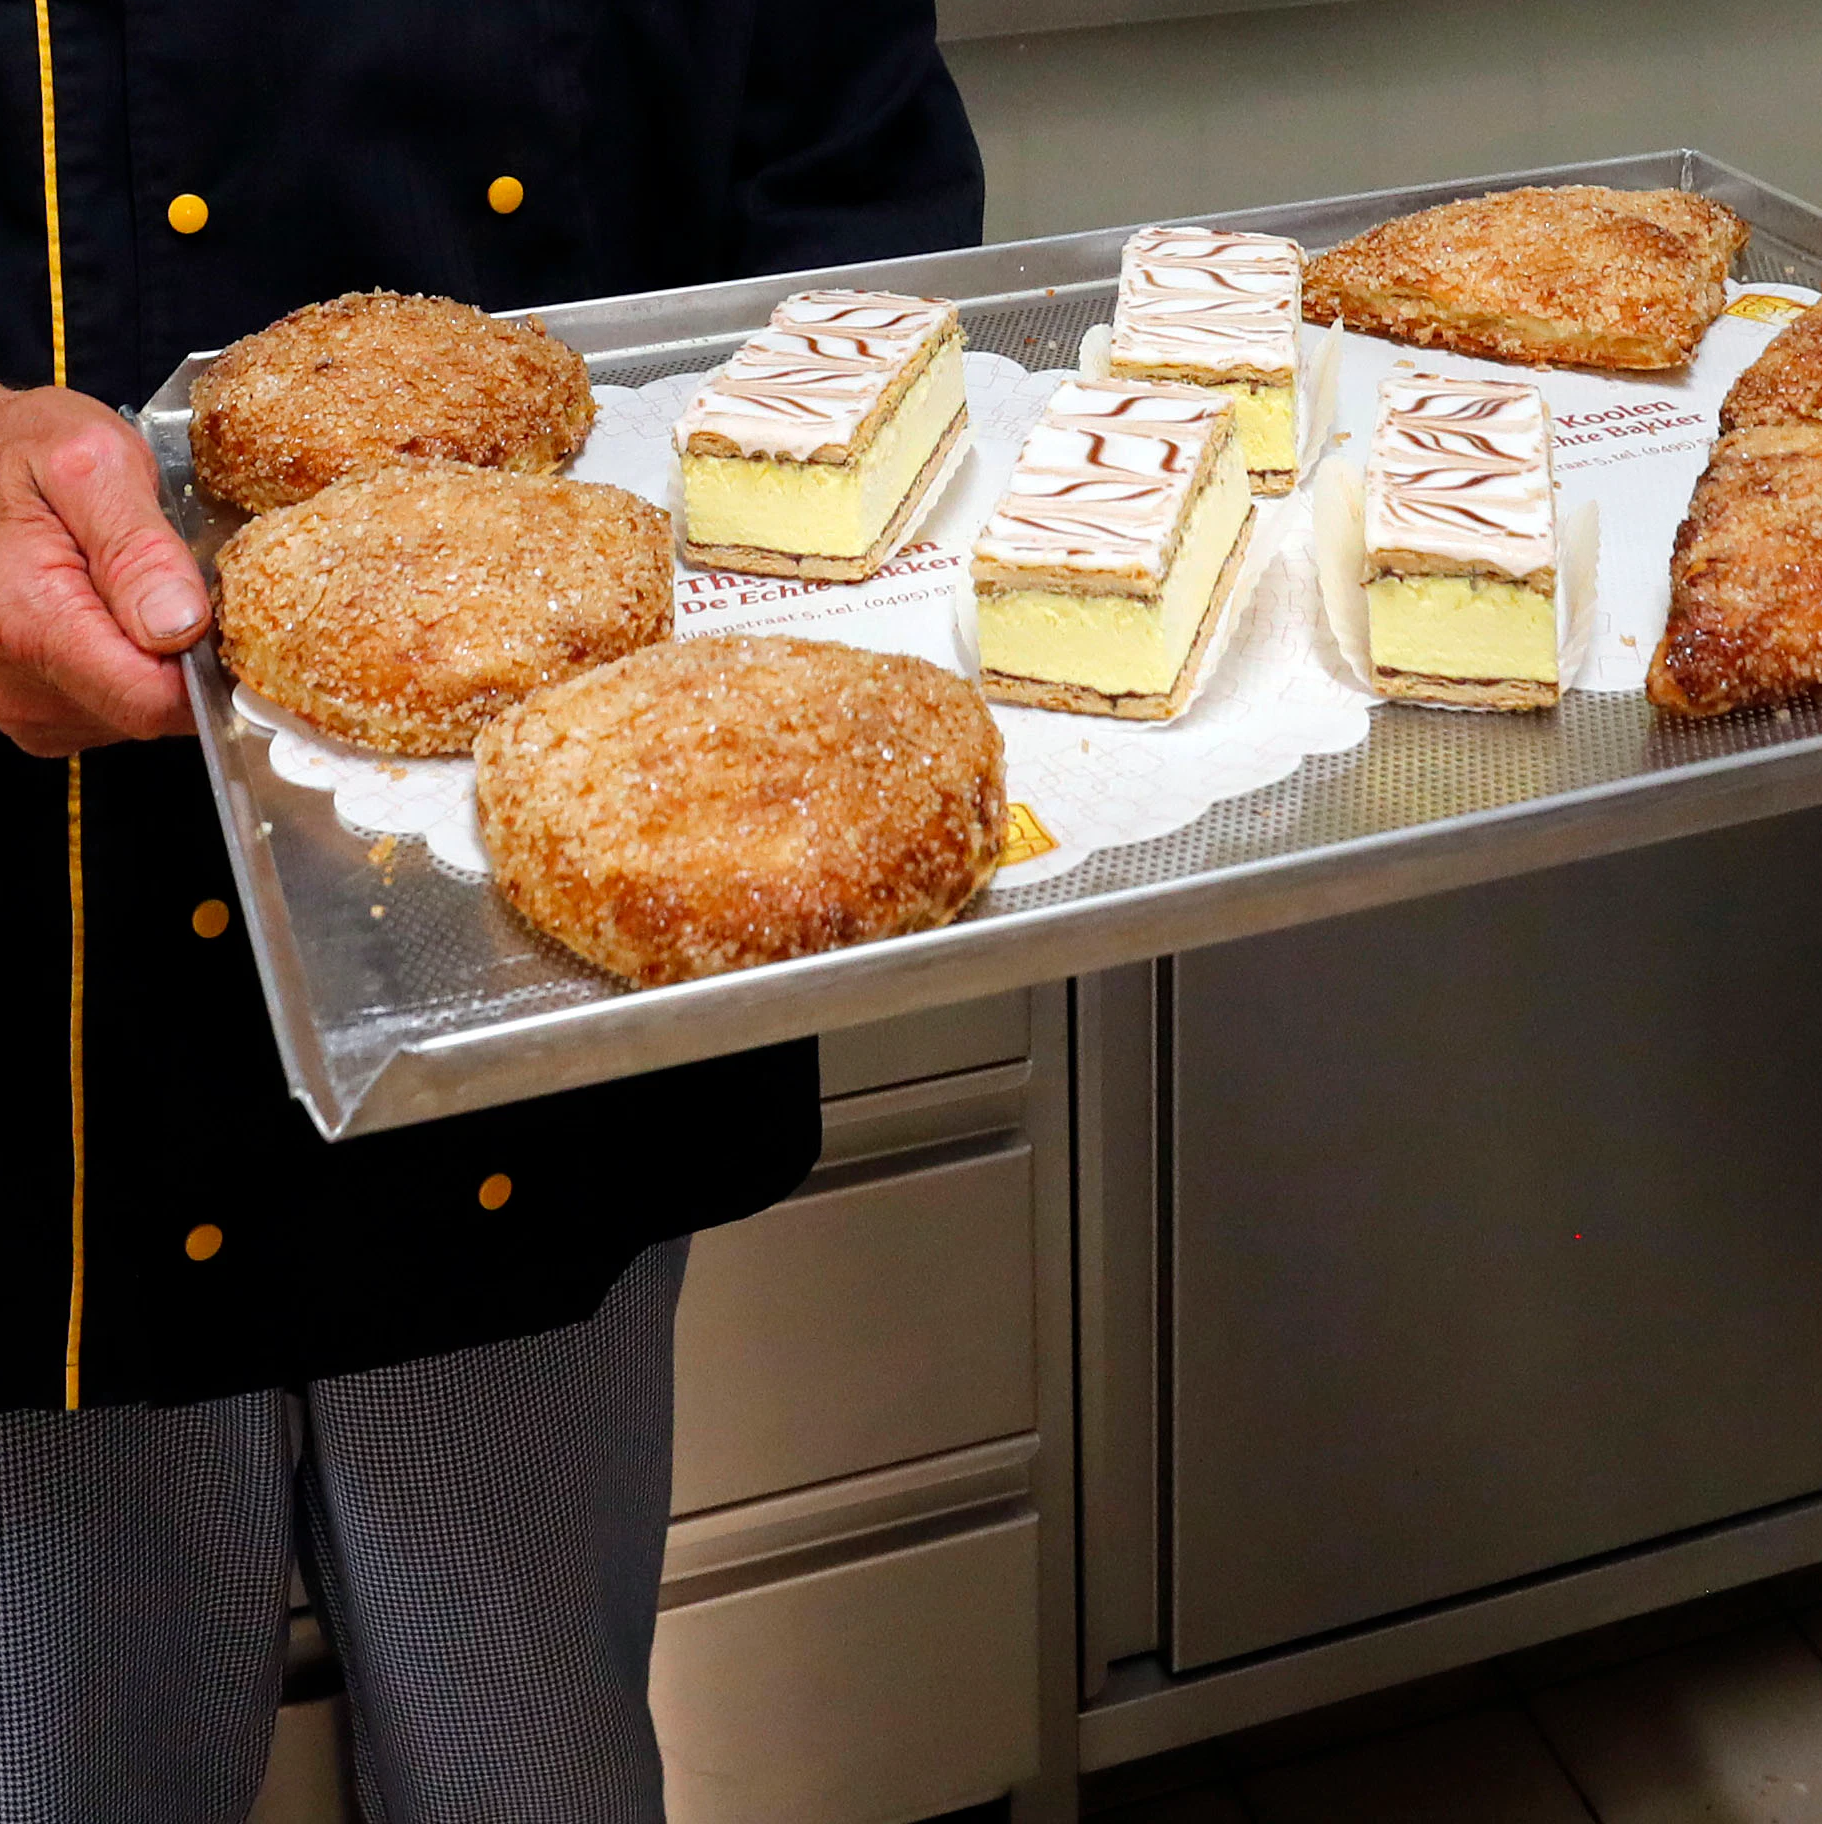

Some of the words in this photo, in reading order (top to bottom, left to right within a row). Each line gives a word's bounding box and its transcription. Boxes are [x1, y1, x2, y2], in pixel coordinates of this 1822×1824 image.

[1554, 401, 1678, 429] Koolen
[1603, 413, 1706, 436] Bakker
[680, 599, 728, 615] De
[864, 588, 930, 609] (0495)
